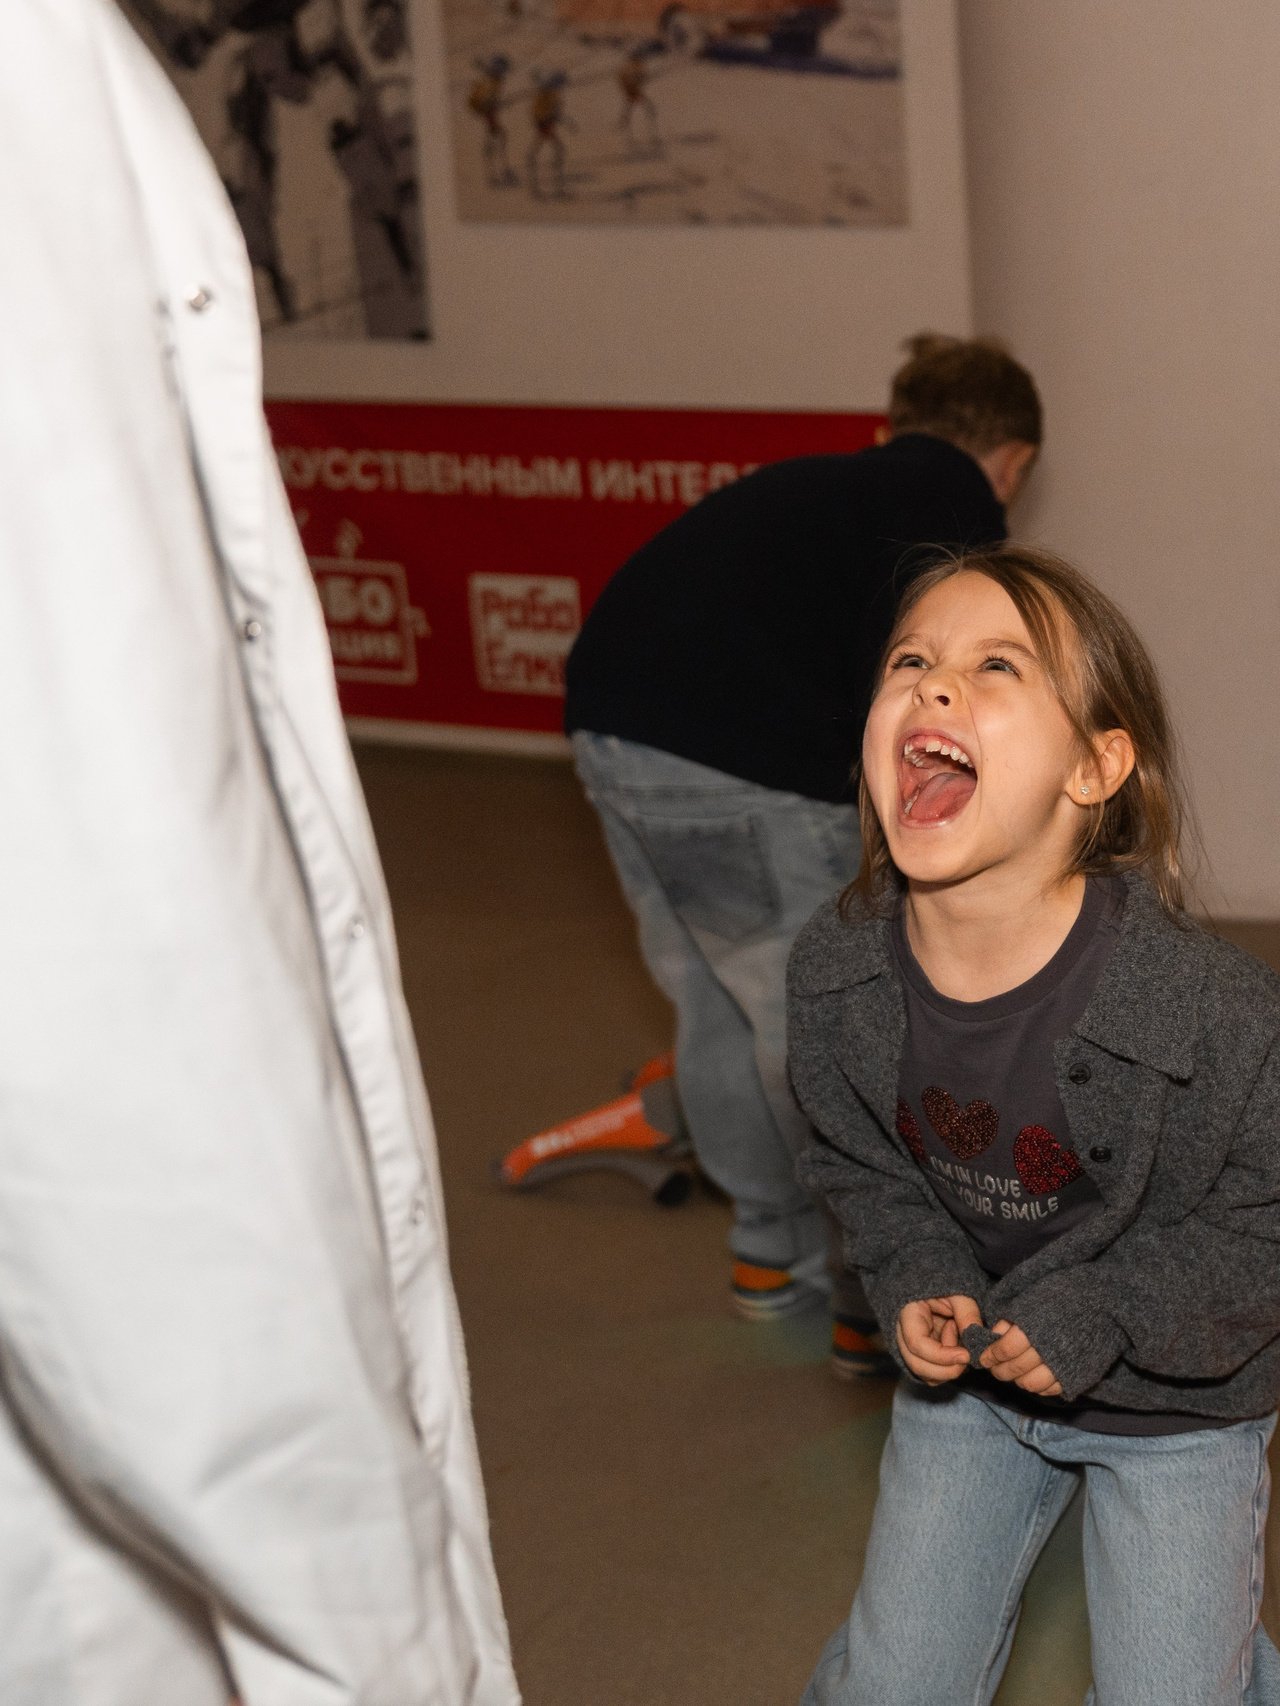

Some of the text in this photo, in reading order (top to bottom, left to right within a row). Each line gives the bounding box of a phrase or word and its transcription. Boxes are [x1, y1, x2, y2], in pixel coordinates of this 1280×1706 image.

[955, 1165, 972, 1185] IN
[975, 1171, 1021, 1198] LOVE
[953, 1185, 1059, 1222] YOUR SMILE
